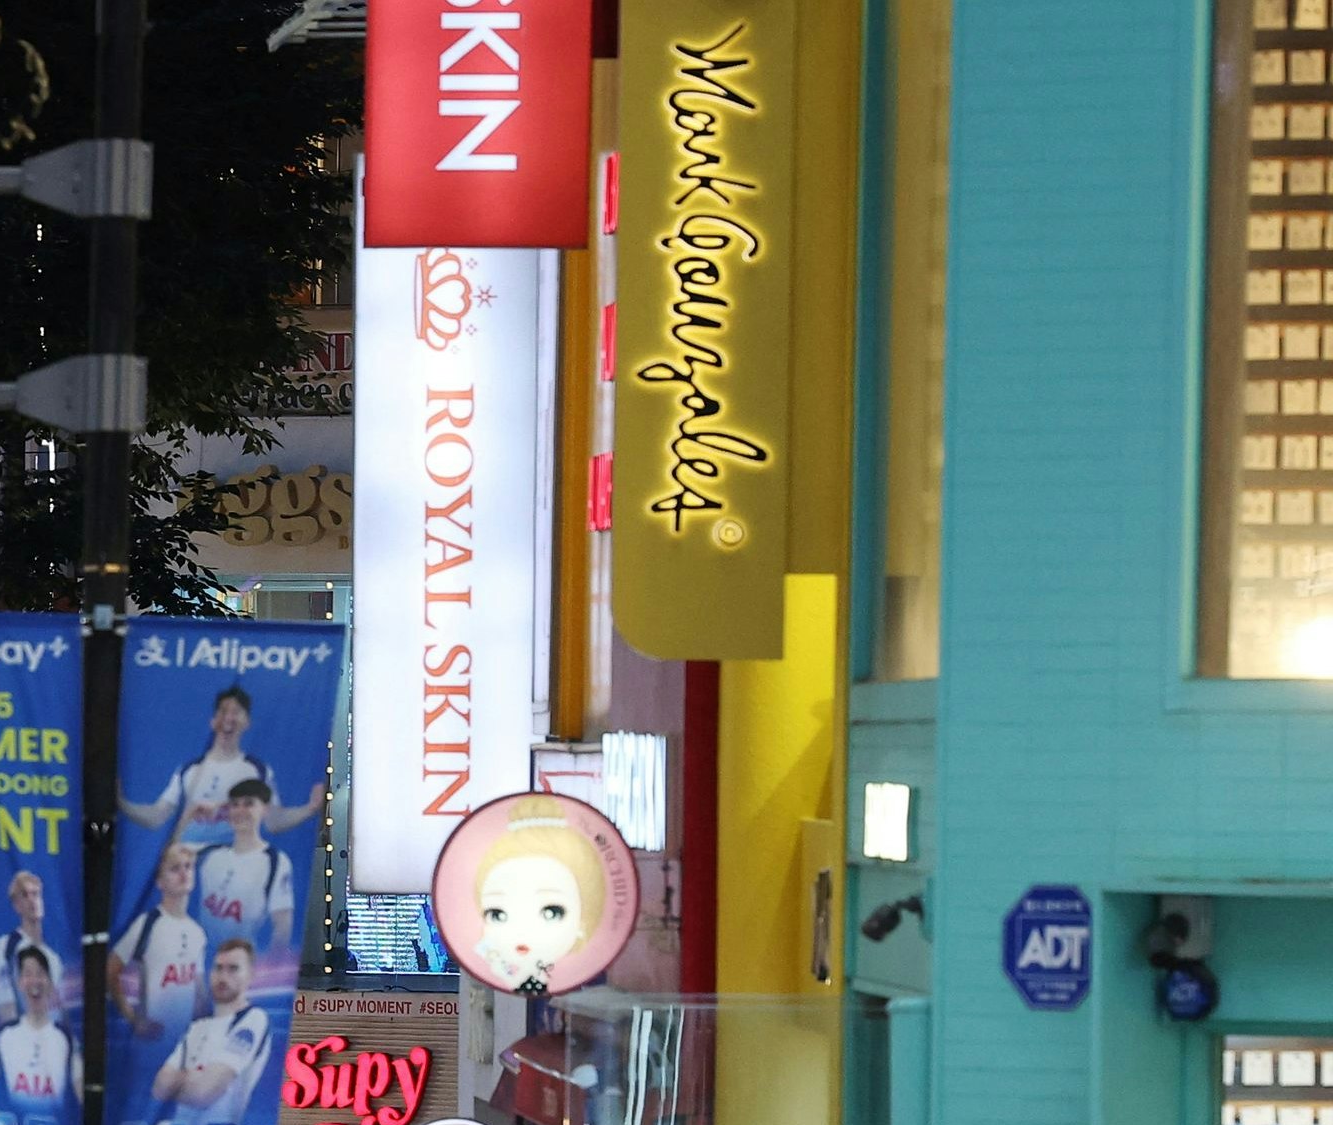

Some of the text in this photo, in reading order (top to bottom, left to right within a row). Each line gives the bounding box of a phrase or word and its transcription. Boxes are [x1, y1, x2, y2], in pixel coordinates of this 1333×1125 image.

[435, 0, 521, 171] KIN
[422, 383, 474, 818] ROYAL SKIN
[1016, 924, 1090, 970] ADT
[312, 1000, 353, 1014] #SUPY
[356, 1001, 412, 1015] MOMENT
